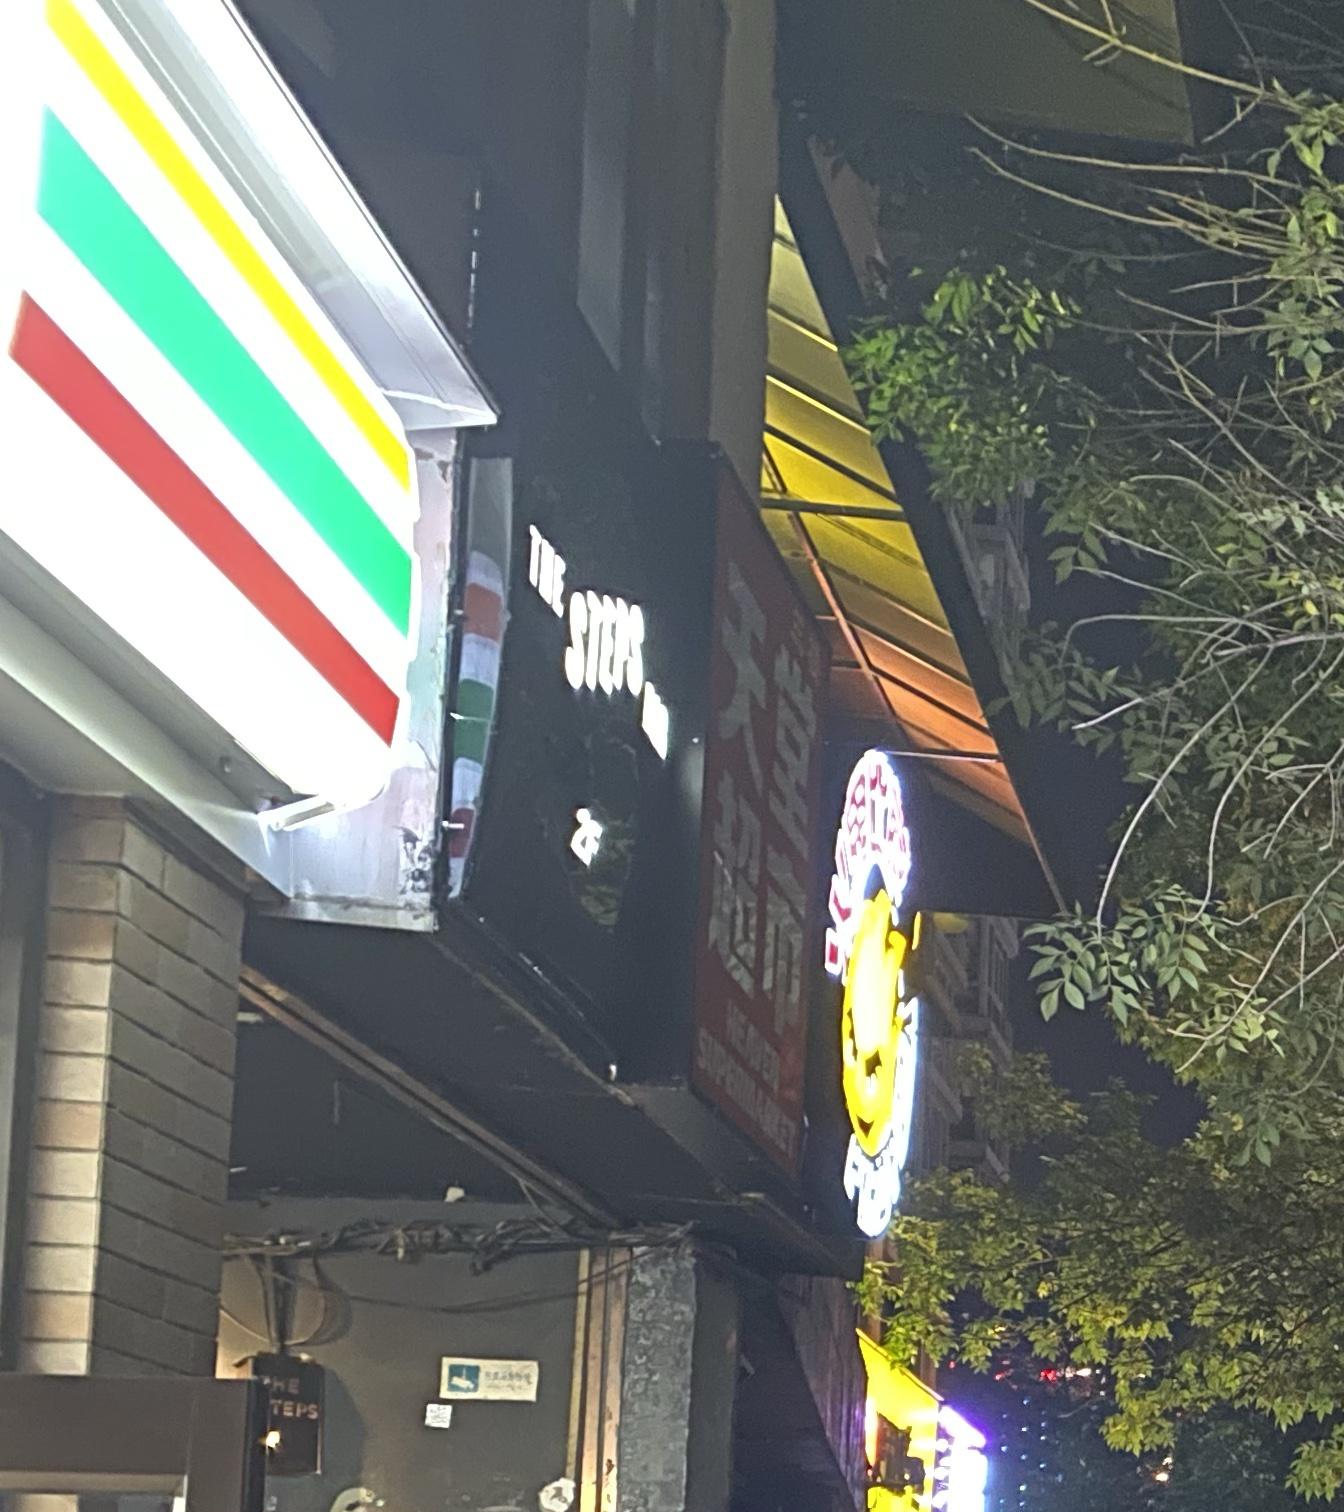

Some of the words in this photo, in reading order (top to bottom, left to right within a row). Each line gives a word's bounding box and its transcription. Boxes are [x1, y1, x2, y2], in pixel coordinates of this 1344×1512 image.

[565, 590, 644, 697] STEPS
[718, 560, 818, 862] 天堂
[707, 768, 807, 1036] 超市
[270, 1399, 319, 1420] TEPS
